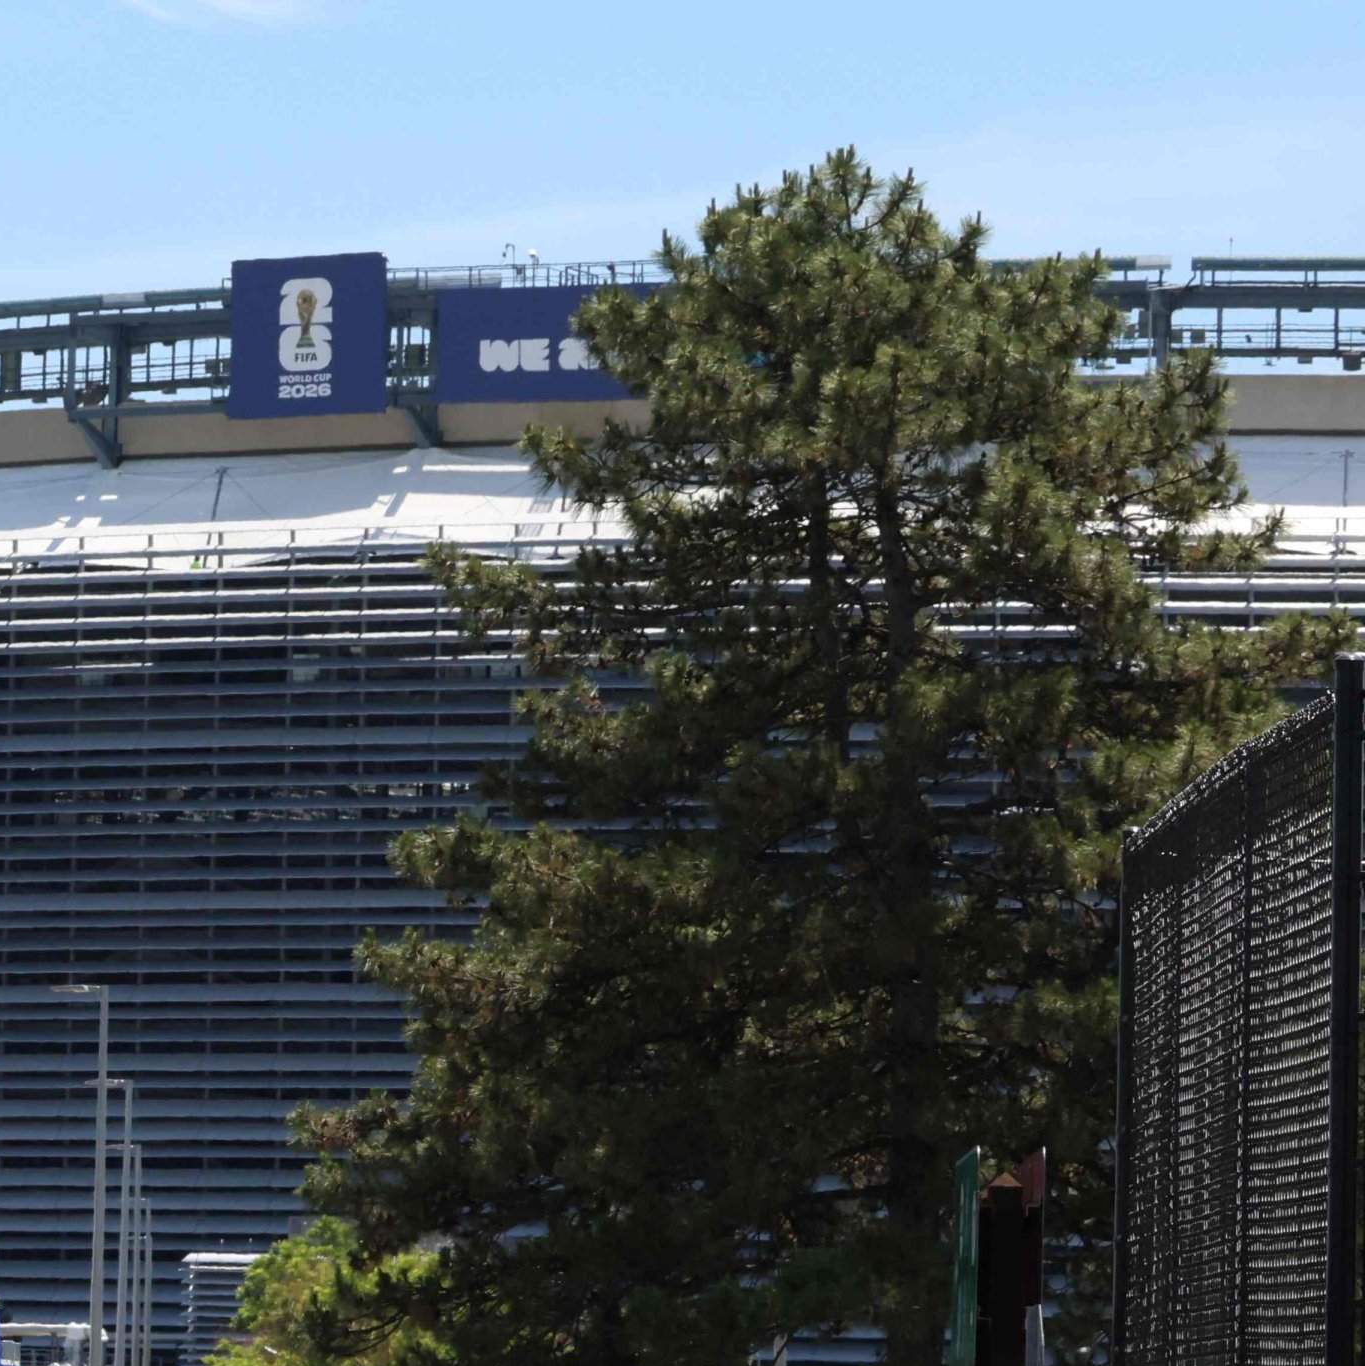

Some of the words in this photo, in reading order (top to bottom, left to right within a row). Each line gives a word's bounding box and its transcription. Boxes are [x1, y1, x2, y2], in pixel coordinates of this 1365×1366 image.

[294, 353, 318, 362] FIFA
[479, 338, 550, 372] WE
[279, 374, 312, 384] WORLD
[313, 373, 332, 382] CUP
[278, 383, 332, 398] 2026
